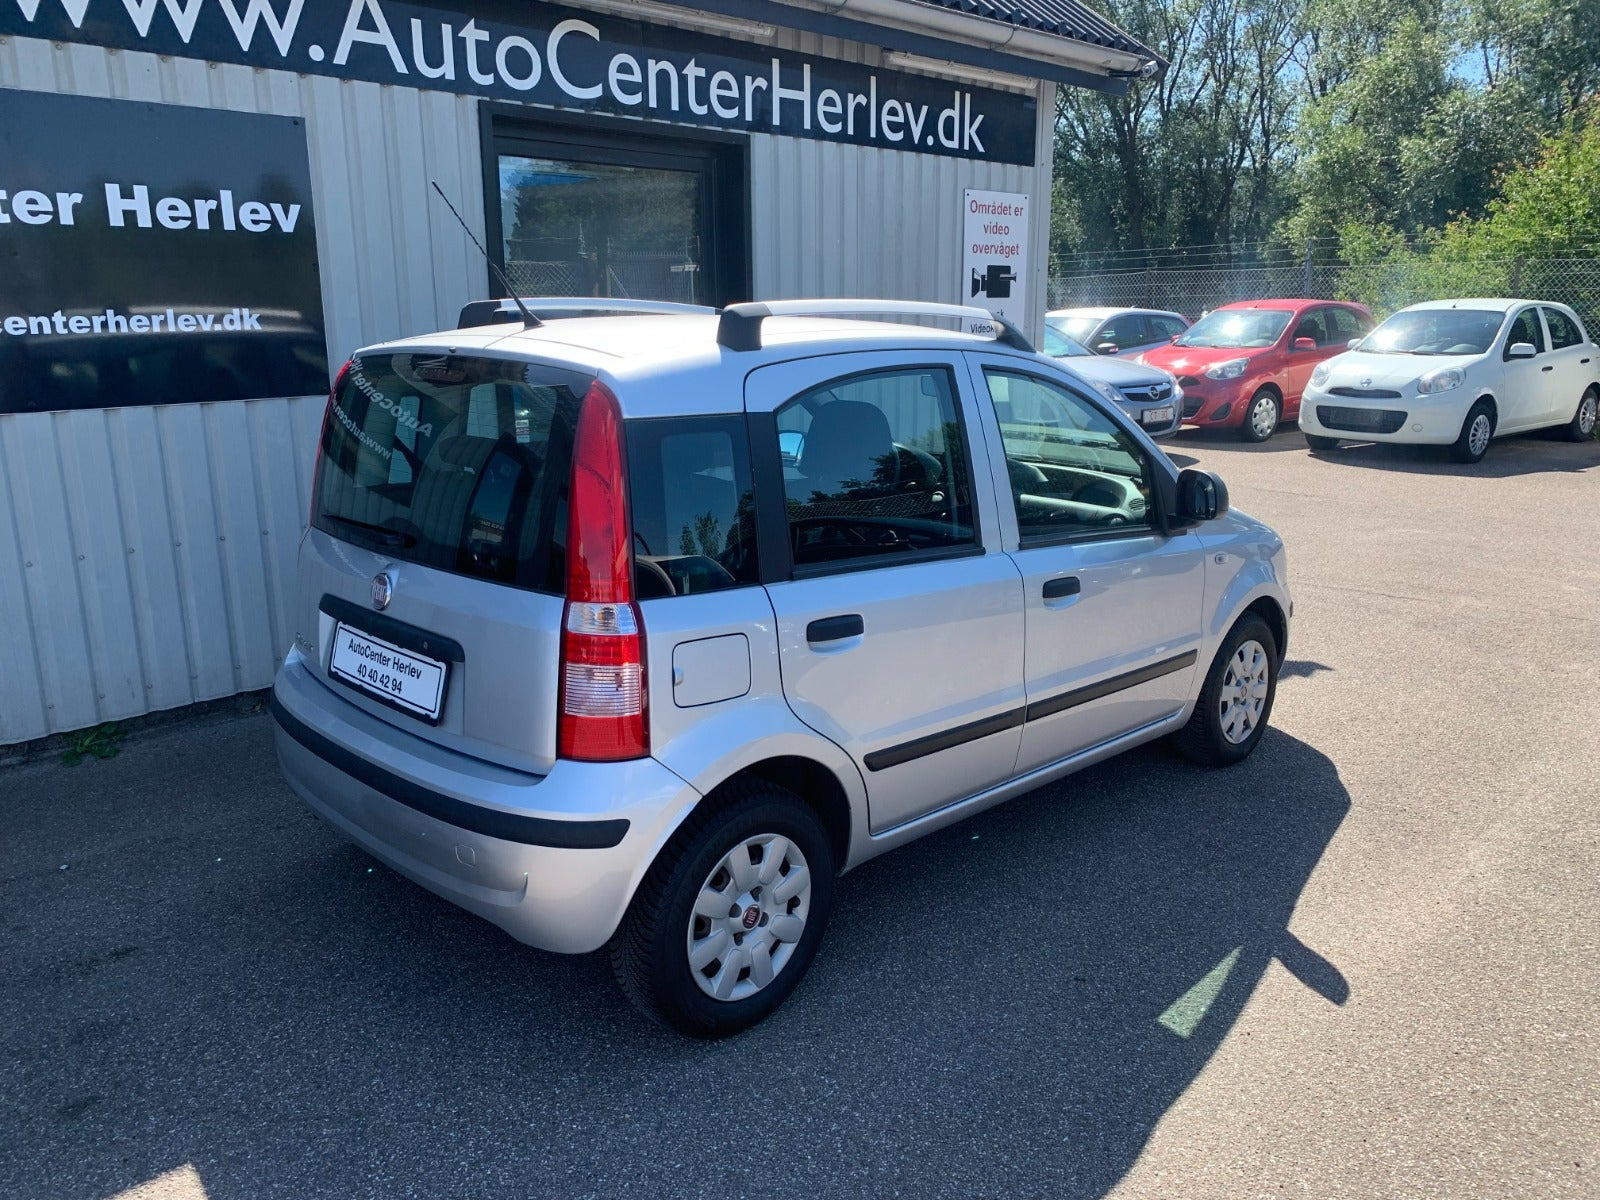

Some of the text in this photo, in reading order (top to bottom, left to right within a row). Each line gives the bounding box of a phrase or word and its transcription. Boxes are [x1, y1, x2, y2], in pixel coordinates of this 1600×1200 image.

[105, 183, 301, 233] Herlev
[970, 199, 1024, 217] Området er
[983, 222, 1010, 236] video
[972, 241, 1020, 259] overvåget
[0, 308, 263, 336] enterherlev.dk
[348, 638, 422, 680] AutoCenter Herlev
[357, 663, 403, 694] 40 40 42 94
